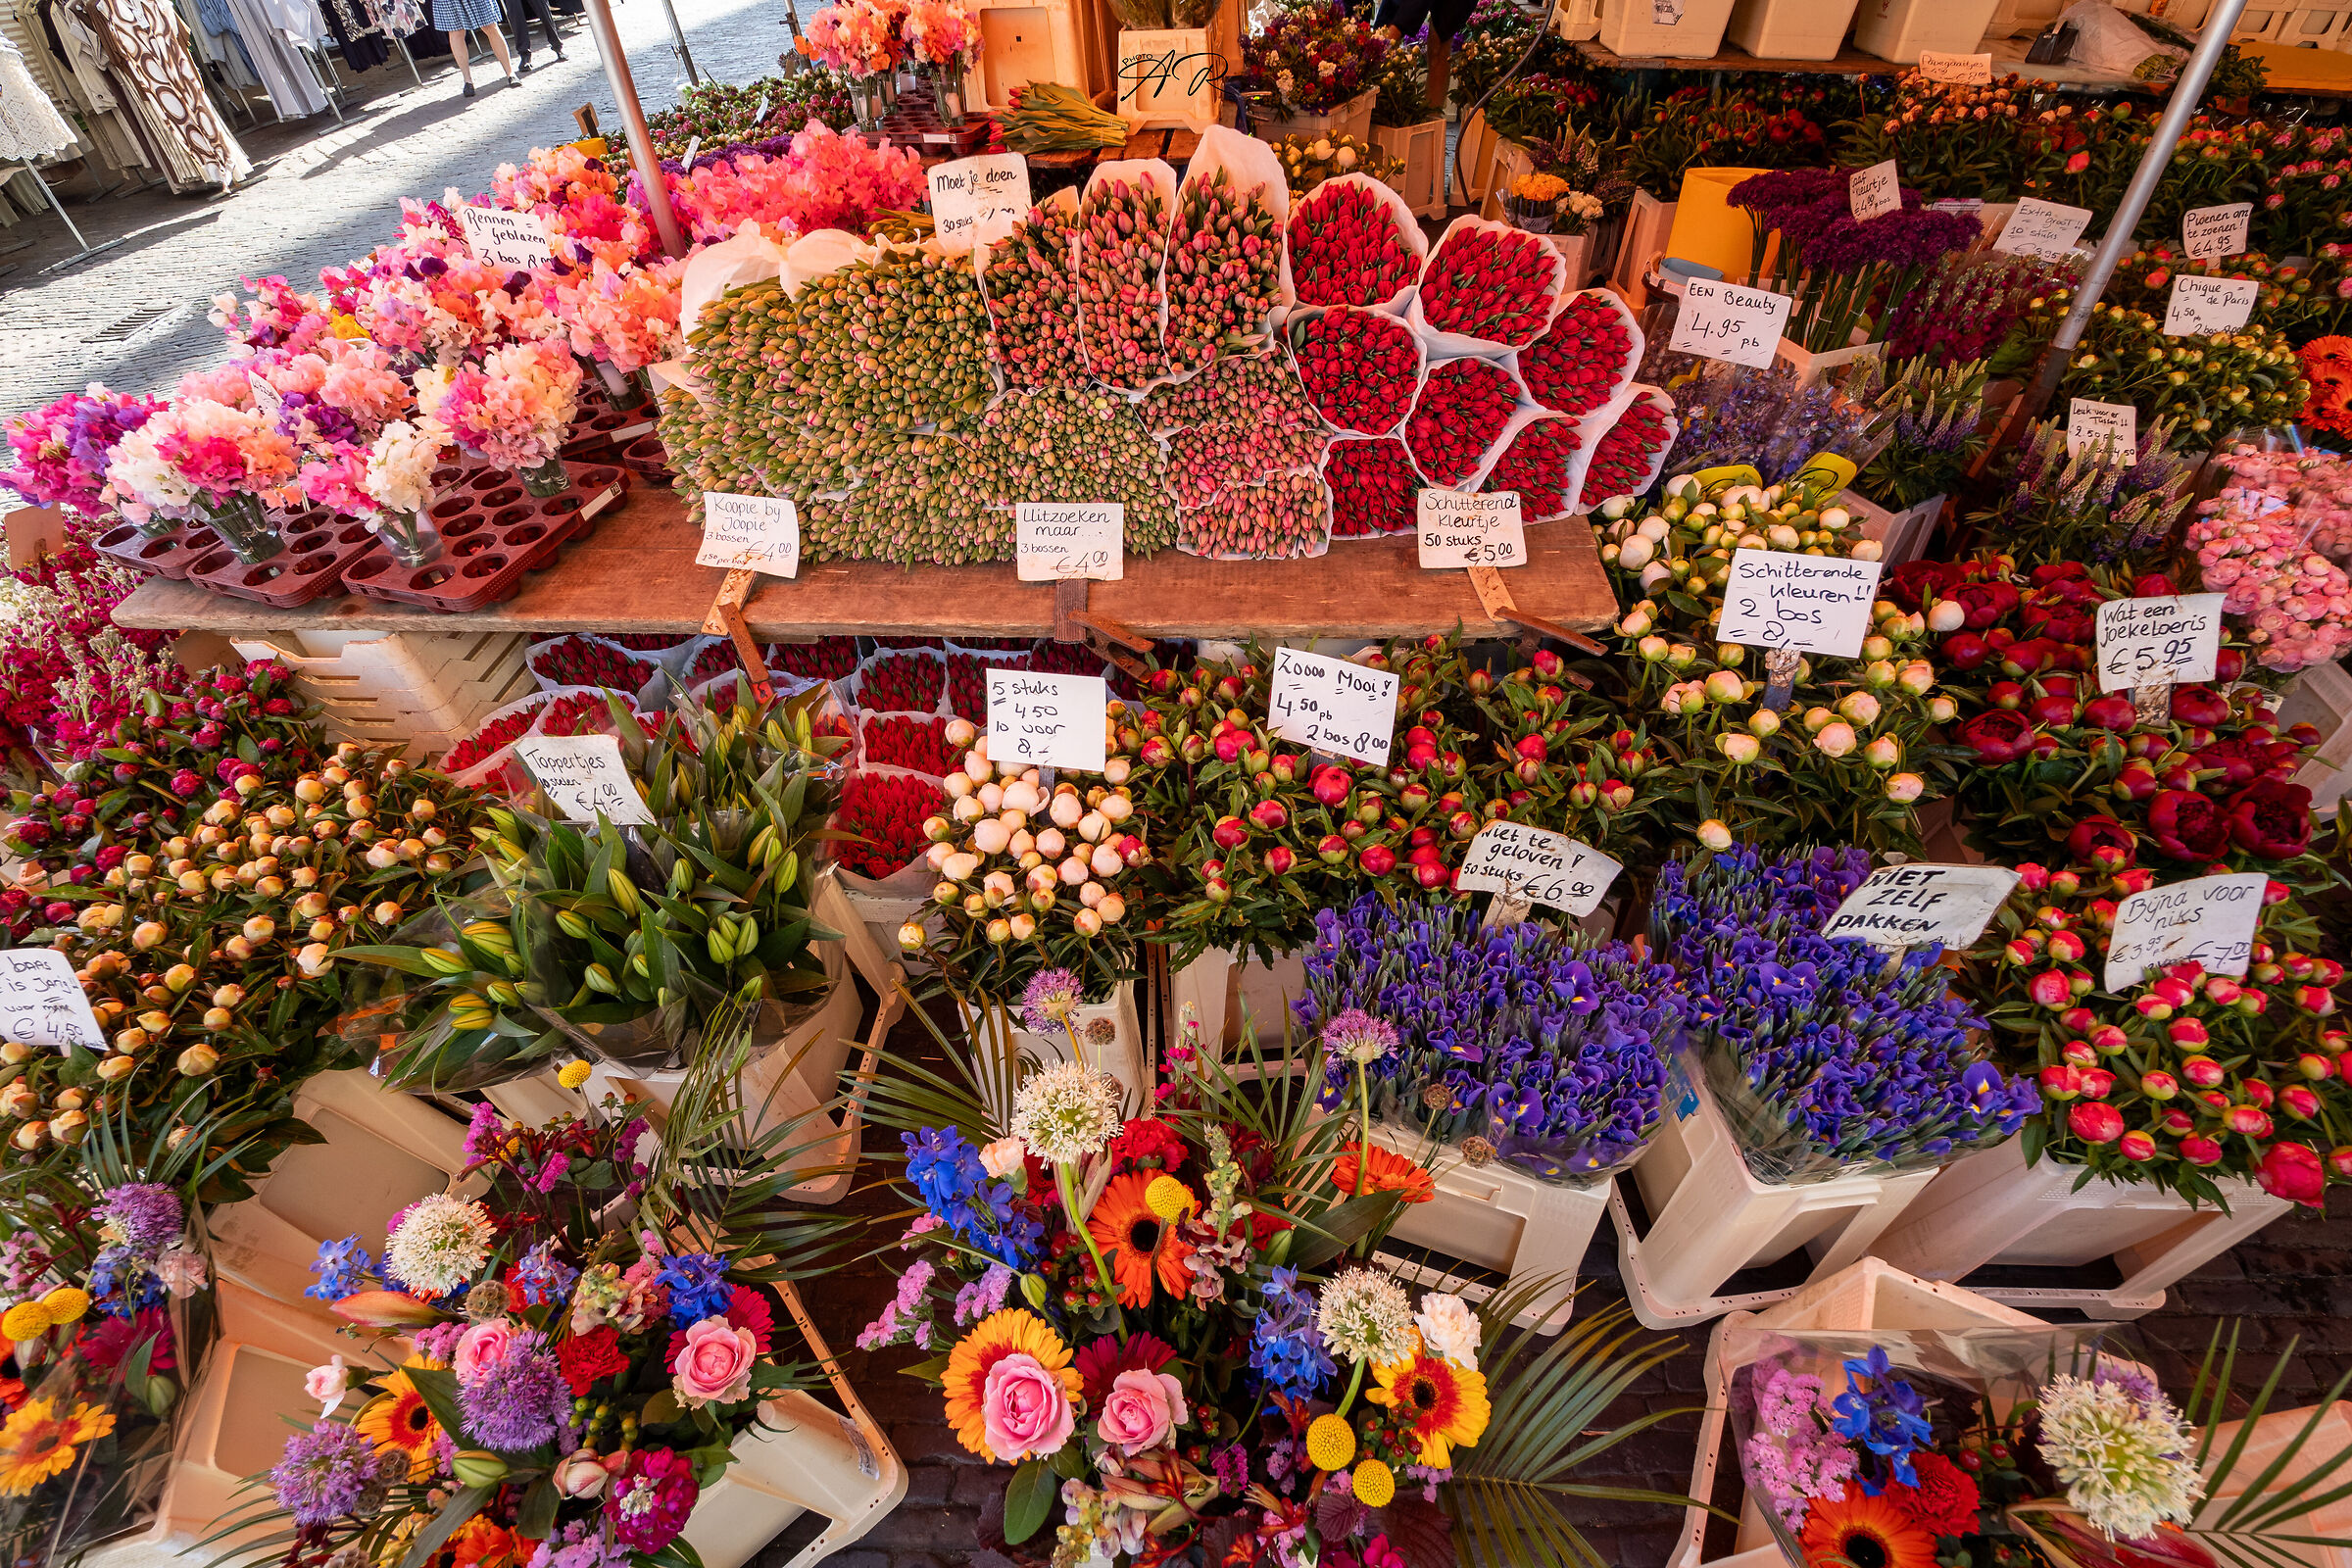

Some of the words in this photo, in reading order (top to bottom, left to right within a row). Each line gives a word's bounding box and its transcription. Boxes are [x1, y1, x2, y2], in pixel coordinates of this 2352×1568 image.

[936, 172, 965, 193] Moet
[967, 170, 979, 196] je
[985, 167, 1017, 183] doen
[464, 208, 514, 232] Rennen
[2019, 204, 2053, 218] Extra
[2186, 212, 2230, 228] Pioenen
[2232, 209, 2249, 219] om
[943, 219, 956, 234] 30
[2030, 227, 2058, 241] stuks
[2187, 228, 2199, 239] te
[479, 248, 495, 268] 3
[497, 251, 521, 265] bos
[1689, 282, 1714, 297] EEN
[1724, 290, 1776, 315] Beauty
[2206, 295, 2219, 305] de
[2223, 291, 2249, 307] Paris
[1691, 312, 1746, 338] 4.95
[2073, 403, 2091, 416] Leuk
[713, 496, 760, 517] Koopie
[764, 500, 782, 523] bij
[1426, 493, 1517, 511] Schitterend
[721, 516, 767, 533] Joopie
[1023, 508, 1111, 523] Uitzoeken
[706, 531, 713, 540] 3
[715, 532, 750, 543] bossen
[1424, 532, 1442, 547] 50
[1446, 535, 1482, 547] stuks
[1020, 543, 1029, 554] 3
[1031, 543, 1069, 554] bossen
[1739, 561, 1868, 580] Schitterende
[1740, 598, 1761, 617] 2
[1776, 599, 1822, 624] bos
[2104, 602, 2138, 624] Wat
[2143, 605, 2176, 617] een
[2099, 614, 2207, 648] joekeloeris
[992, 681, 1005, 696] 5
[1011, 678, 1058, 697] stuks
[1276, 692, 1318, 717] 4.50
[1319, 710, 1333, 722] pb
[996, 720, 1009, 732] 10
[1022, 723, 1065, 734] voor
[1306, 724, 1319, 741] 2
[1323, 728, 1350, 745] bos
[1353, 731, 1389, 755] 8.00
[525, 748, 606, 774] Toppertjes
[1529, 833, 1552, 849] te
[1463, 862, 1478, 875] 50
[1480, 865, 1525, 882] stuks
[1866, 888, 1948, 912] ZELF
[2123, 891, 2188, 924] Bijna
[2204, 885, 2255, 901] voor
[2154, 907, 2204, 930] niks
[6, 977, 27, 992] is
[13, 1017, 35, 1039] €
